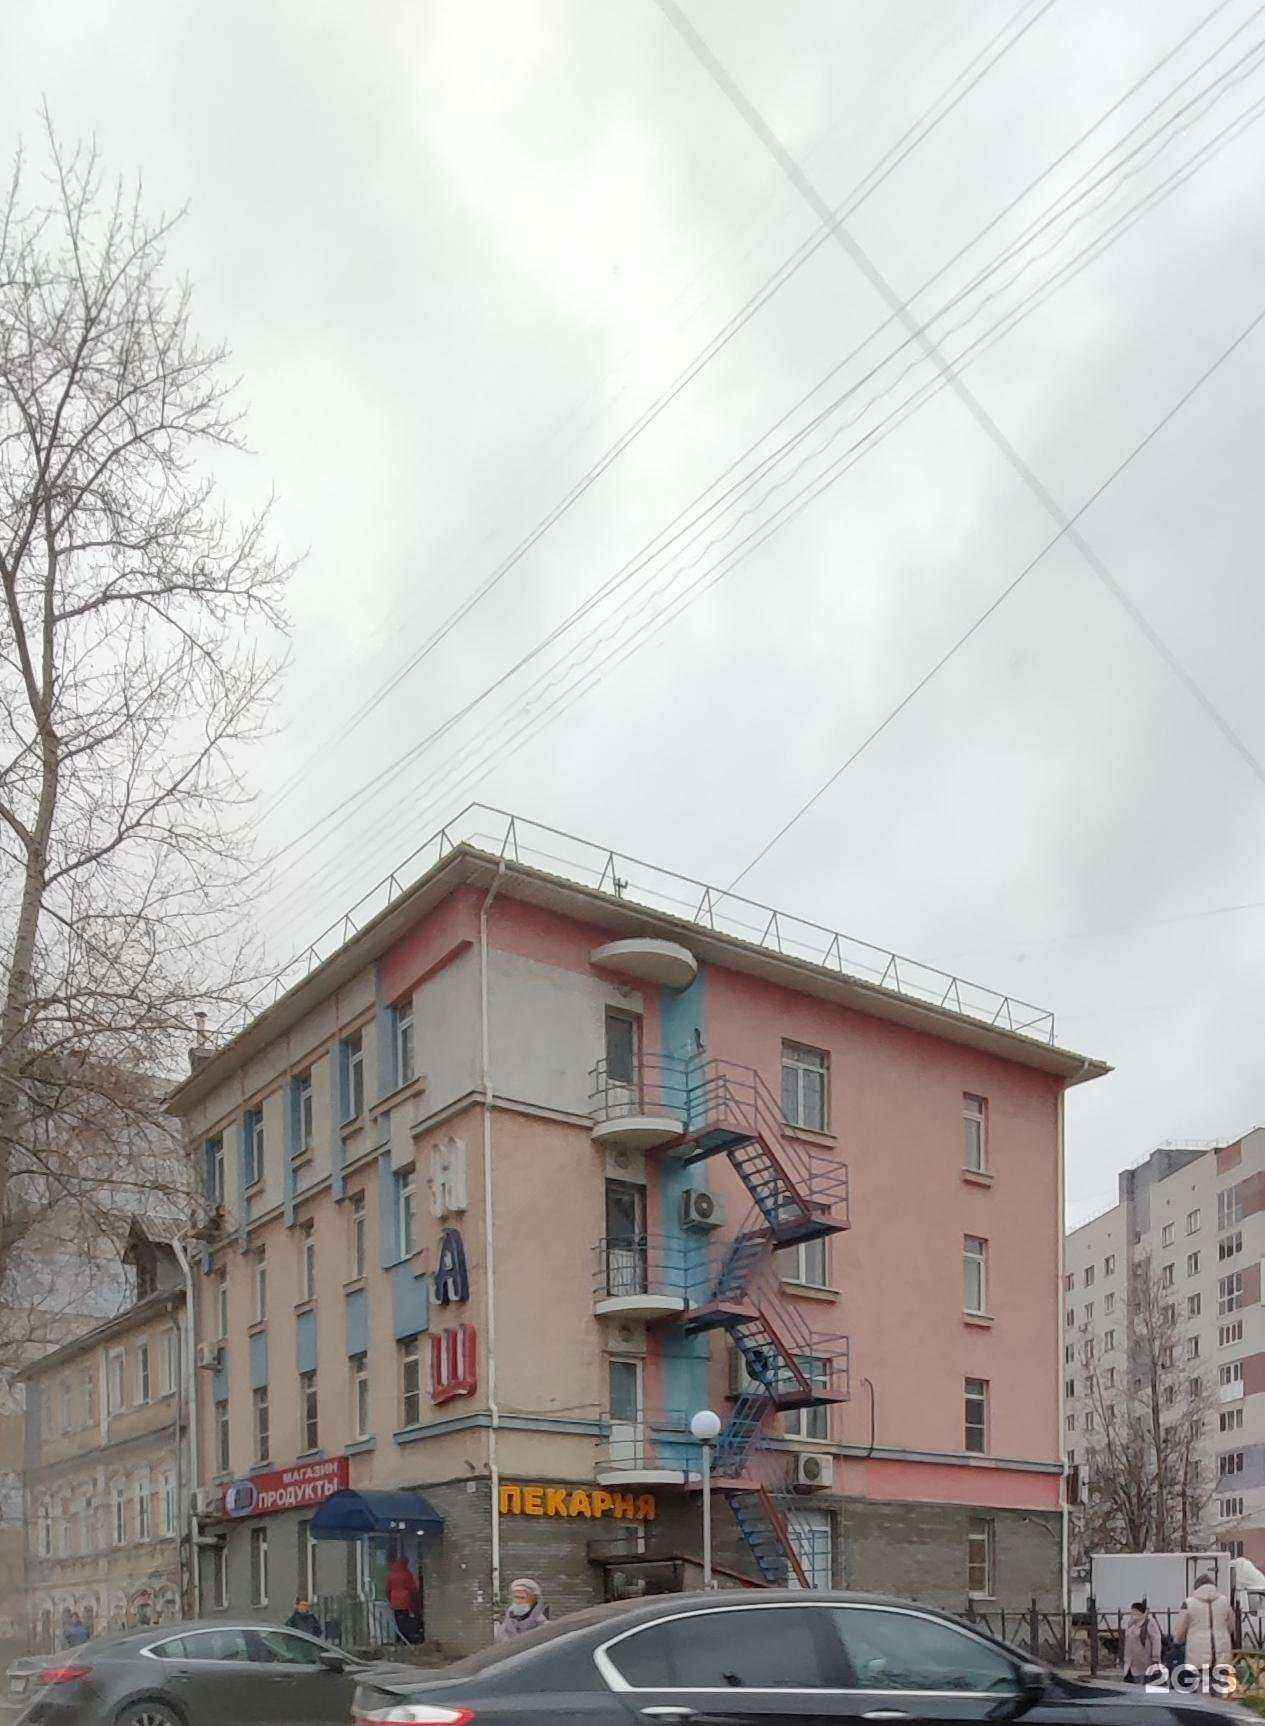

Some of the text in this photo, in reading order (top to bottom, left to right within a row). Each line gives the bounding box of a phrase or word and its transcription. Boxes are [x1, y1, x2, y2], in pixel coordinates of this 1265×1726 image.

[282, 1462, 339, 1484] МАГАЗИН
[258, 1478, 339, 1508] ПРОДУКТЫ
[499, 1484, 657, 1520] ПЕКАРНЯ
